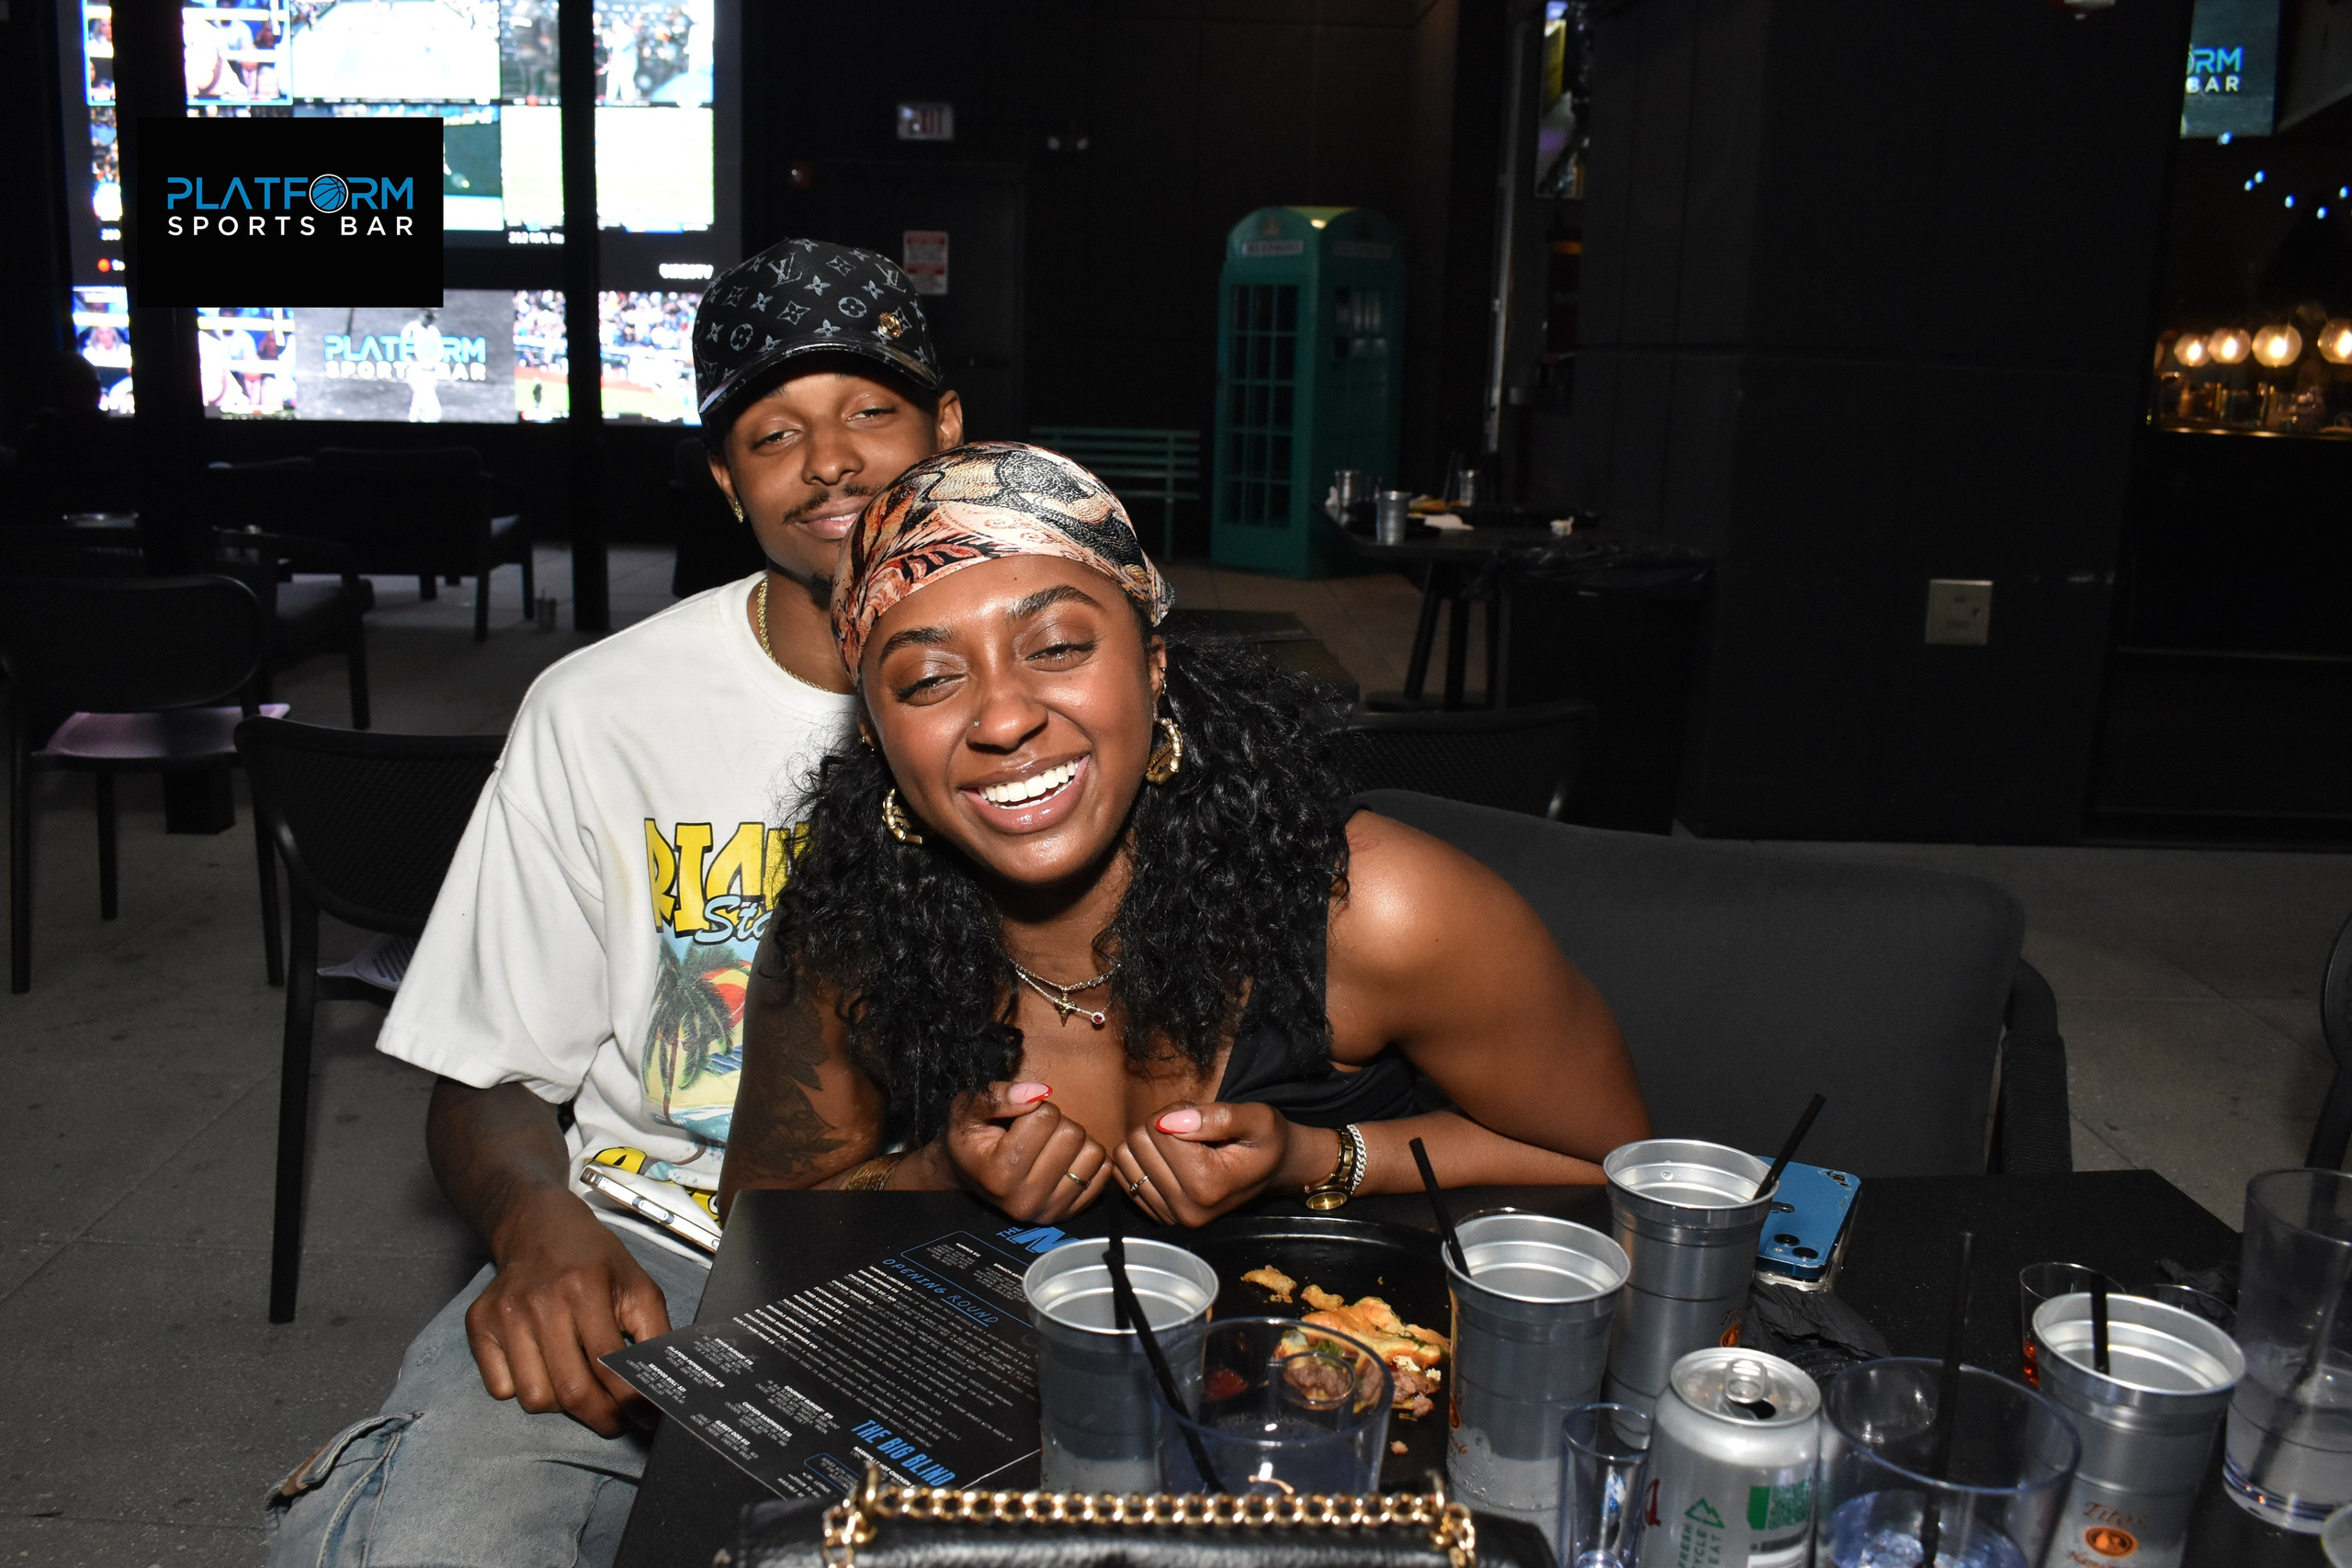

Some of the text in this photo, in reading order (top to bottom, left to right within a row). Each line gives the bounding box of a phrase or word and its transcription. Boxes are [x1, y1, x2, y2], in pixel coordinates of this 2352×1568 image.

[2188, 46, 2244, 73] RM
[2186, 75, 2240, 93] BAR
[325, 360, 415, 380] SPORT
[880, 1257, 950, 1294] OPENING
[944, 1293, 1001, 1325] ROUND
[850, 1419, 956, 1487] THE BIG BLIND
[1693, 1528, 1707, 1568] YCLE
